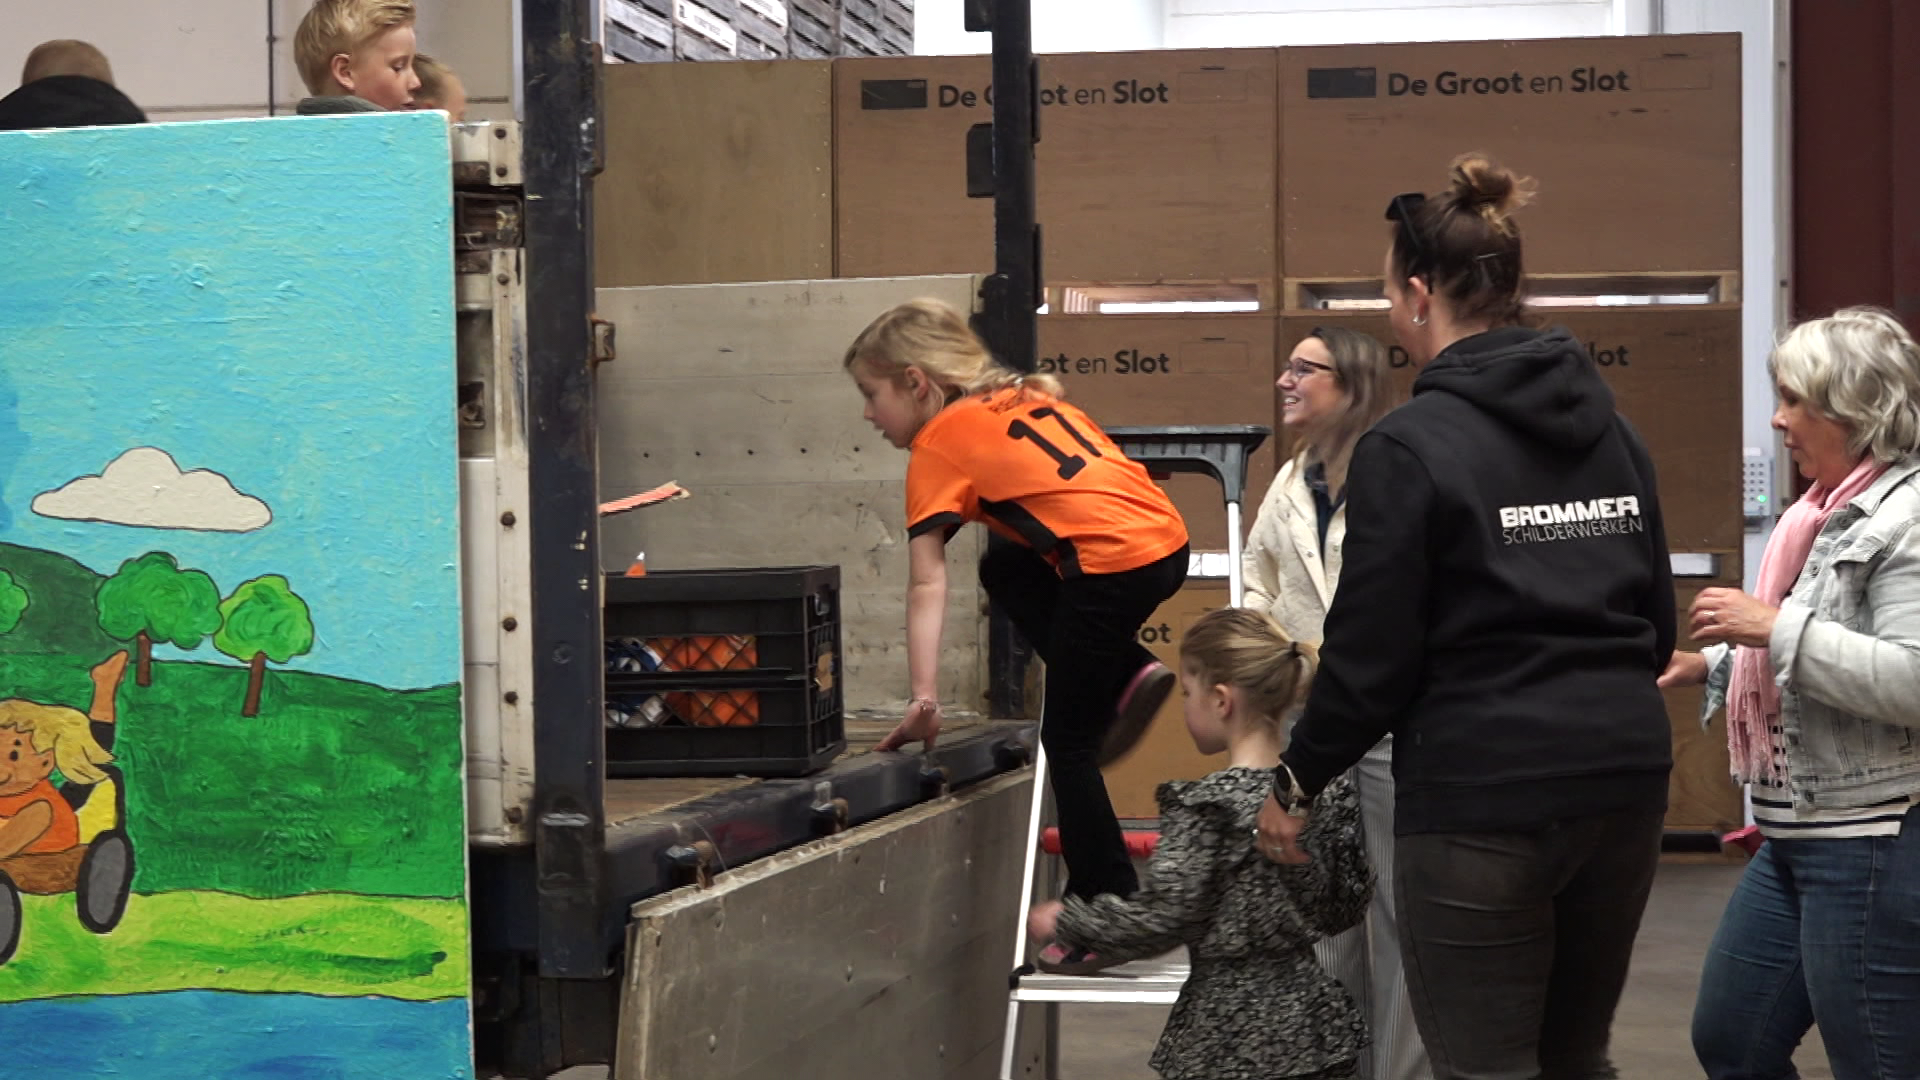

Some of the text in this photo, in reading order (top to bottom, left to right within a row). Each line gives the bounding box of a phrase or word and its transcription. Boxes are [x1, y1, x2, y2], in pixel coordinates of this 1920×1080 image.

[937, 84, 977, 108] De
[1074, 86, 1106, 105] en
[1113, 79, 1169, 105] Slot
[1387, 67, 1630, 96] De Groot en Slot
[1075, 357, 1107, 375] en
[1114, 349, 1170, 375] Slot
[1388, 341, 1629, 368] D lot
[1007, 406, 1103, 481] 17
[1499, 495, 1640, 528] BROMMER
[1502, 517, 1644, 546] SCHILDERWERKEN
[1140, 622, 1171, 644] ot
